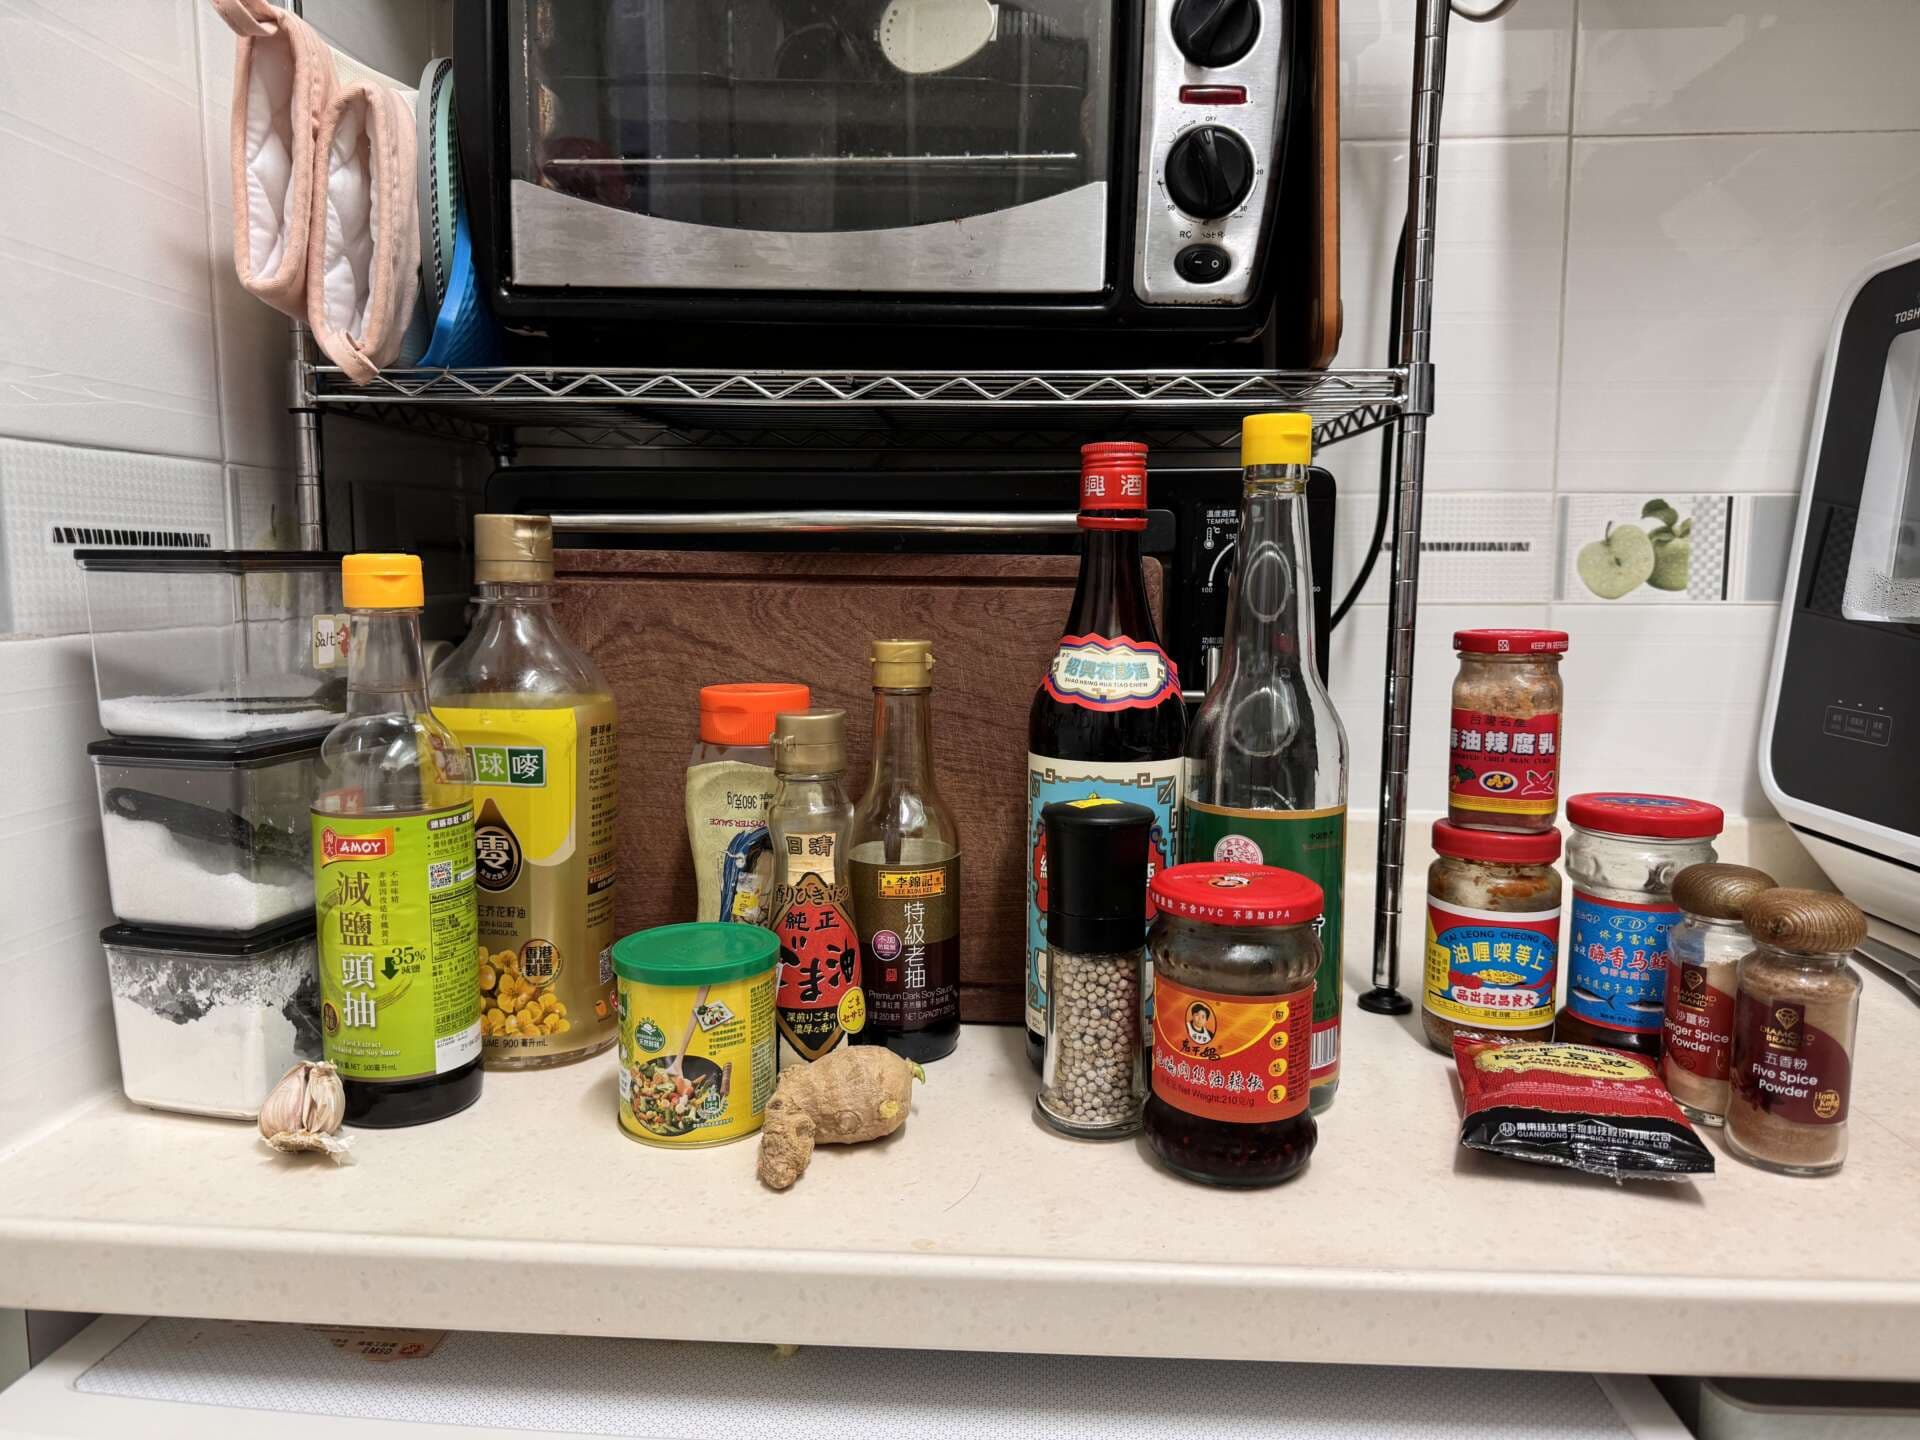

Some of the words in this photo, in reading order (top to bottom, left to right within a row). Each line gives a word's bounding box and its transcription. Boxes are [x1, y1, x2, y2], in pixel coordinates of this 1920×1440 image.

[315, 632, 336, 647] Salt
[340, 840, 382, 854] AMOY
[786, 835, 834, 857] 日清
[895, 875, 933, 888] 李錦記
[785, 910, 840, 932] 純正
[904, 901, 926, 989] 特級老抽
[1462, 929, 1495, 939] LEONG
[1501, 932, 1540, 943] CHEONG
[336, 870, 377, 1029] 減鹽頭抽
[868, 990, 902, 1000] Premium
[902, 991, 921, 1000] Dark
[921, 990, 935, 1001] Soy
[1664, 1016, 1693, 1037] Ginger
[1695, 1027, 1729, 1044] Spice
[380, 1048, 401, 1056] Sauce
[503, 1038, 519, 1048] 900
[1671, 1033, 1711, 1054] Powder
[1764, 1051, 1808, 1072] 五香粉
[1752, 1063, 1776, 1080] Five
[1780, 1069, 1818, 1087] Spice
[1758, 1078, 1809, 1099] Powder
[1517, 1130, 1568, 1140] GUANGDONG
